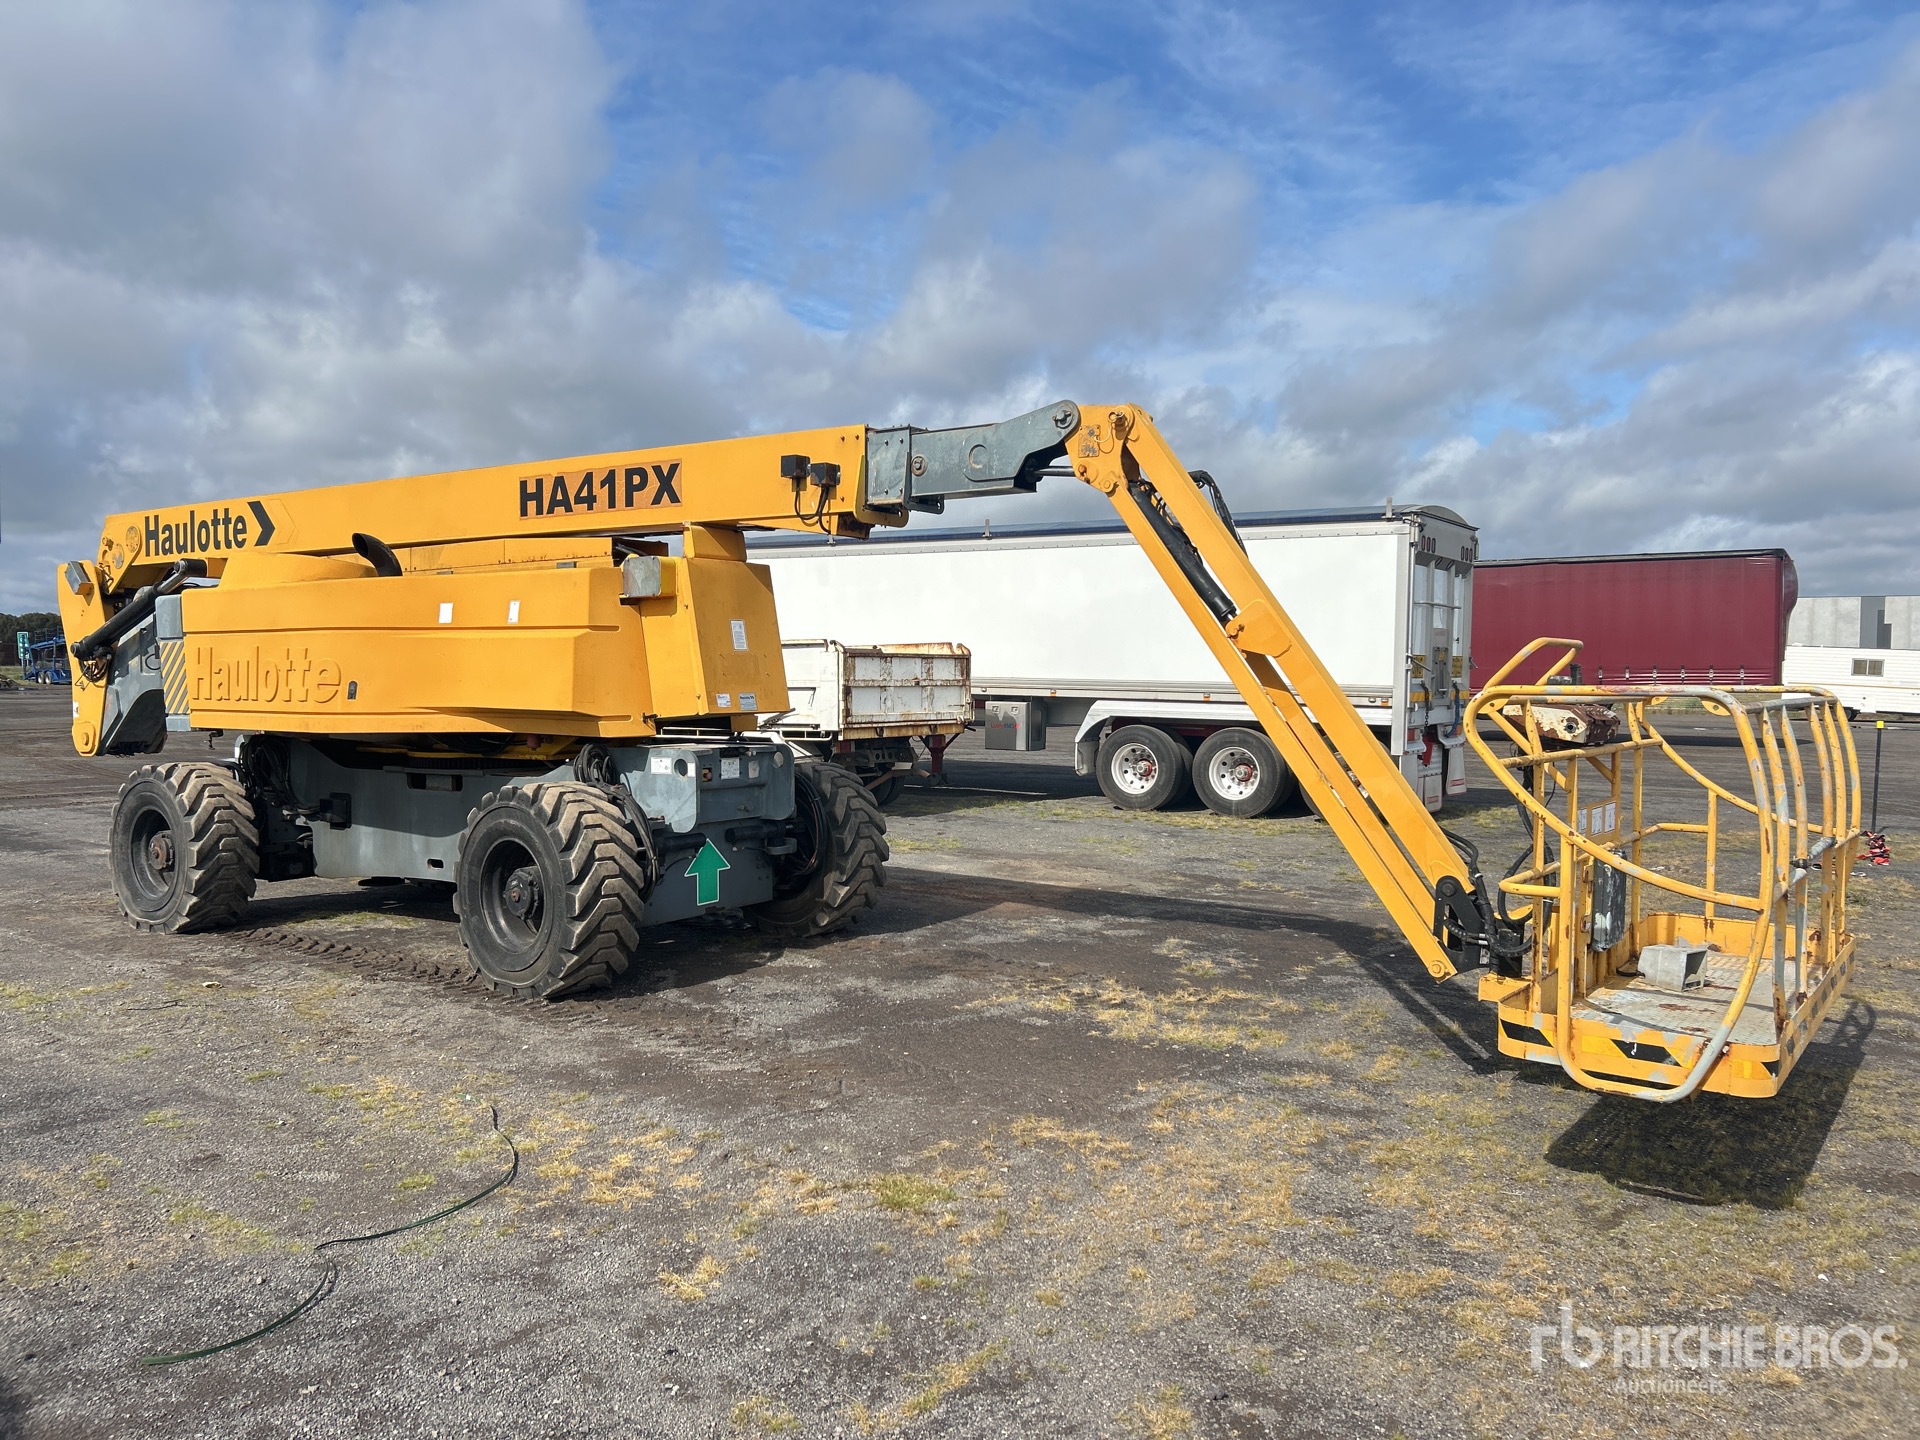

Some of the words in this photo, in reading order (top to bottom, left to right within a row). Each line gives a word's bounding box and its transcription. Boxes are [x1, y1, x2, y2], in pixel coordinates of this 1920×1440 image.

[519, 463, 682, 517] HA41PX
[144, 508, 248, 558] Haulotte
[191, 646, 342, 704] Haulotte
